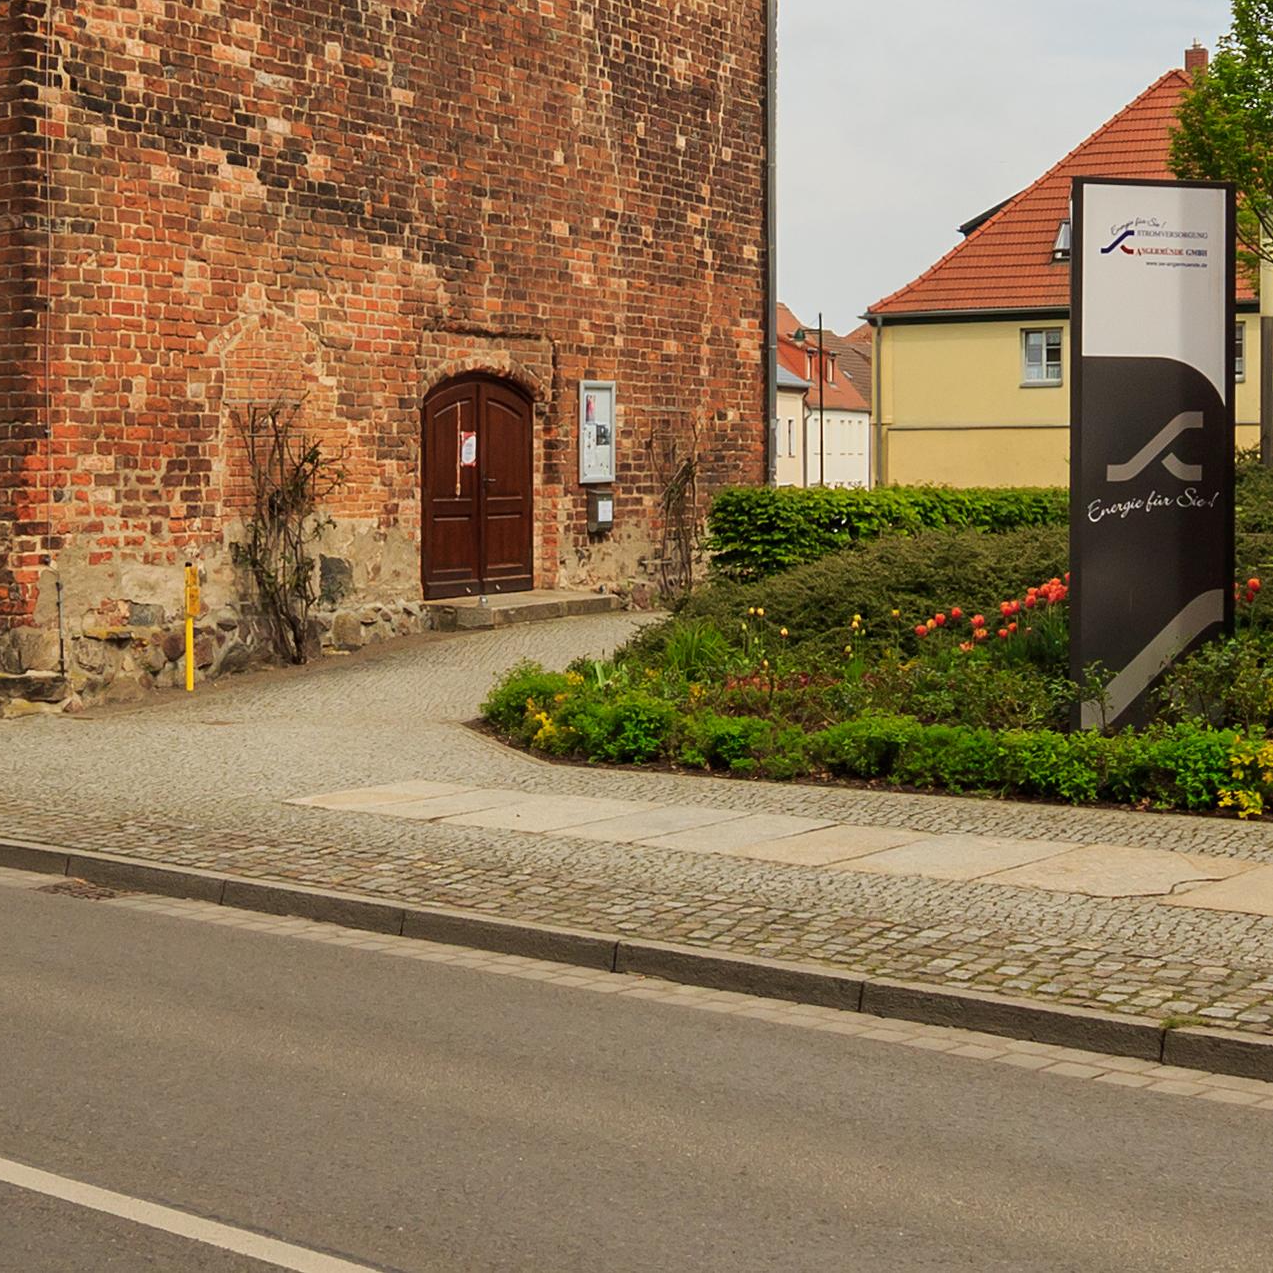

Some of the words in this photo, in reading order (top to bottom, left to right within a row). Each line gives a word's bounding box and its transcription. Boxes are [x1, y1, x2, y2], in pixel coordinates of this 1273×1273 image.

[1137, 229, 1208, 240] STROMVERSORGUNG
[1185, 249, 1208, 257] GMBH
[1087, 498, 1144, 523] Energie
[1145, 490, 1174, 513] für
